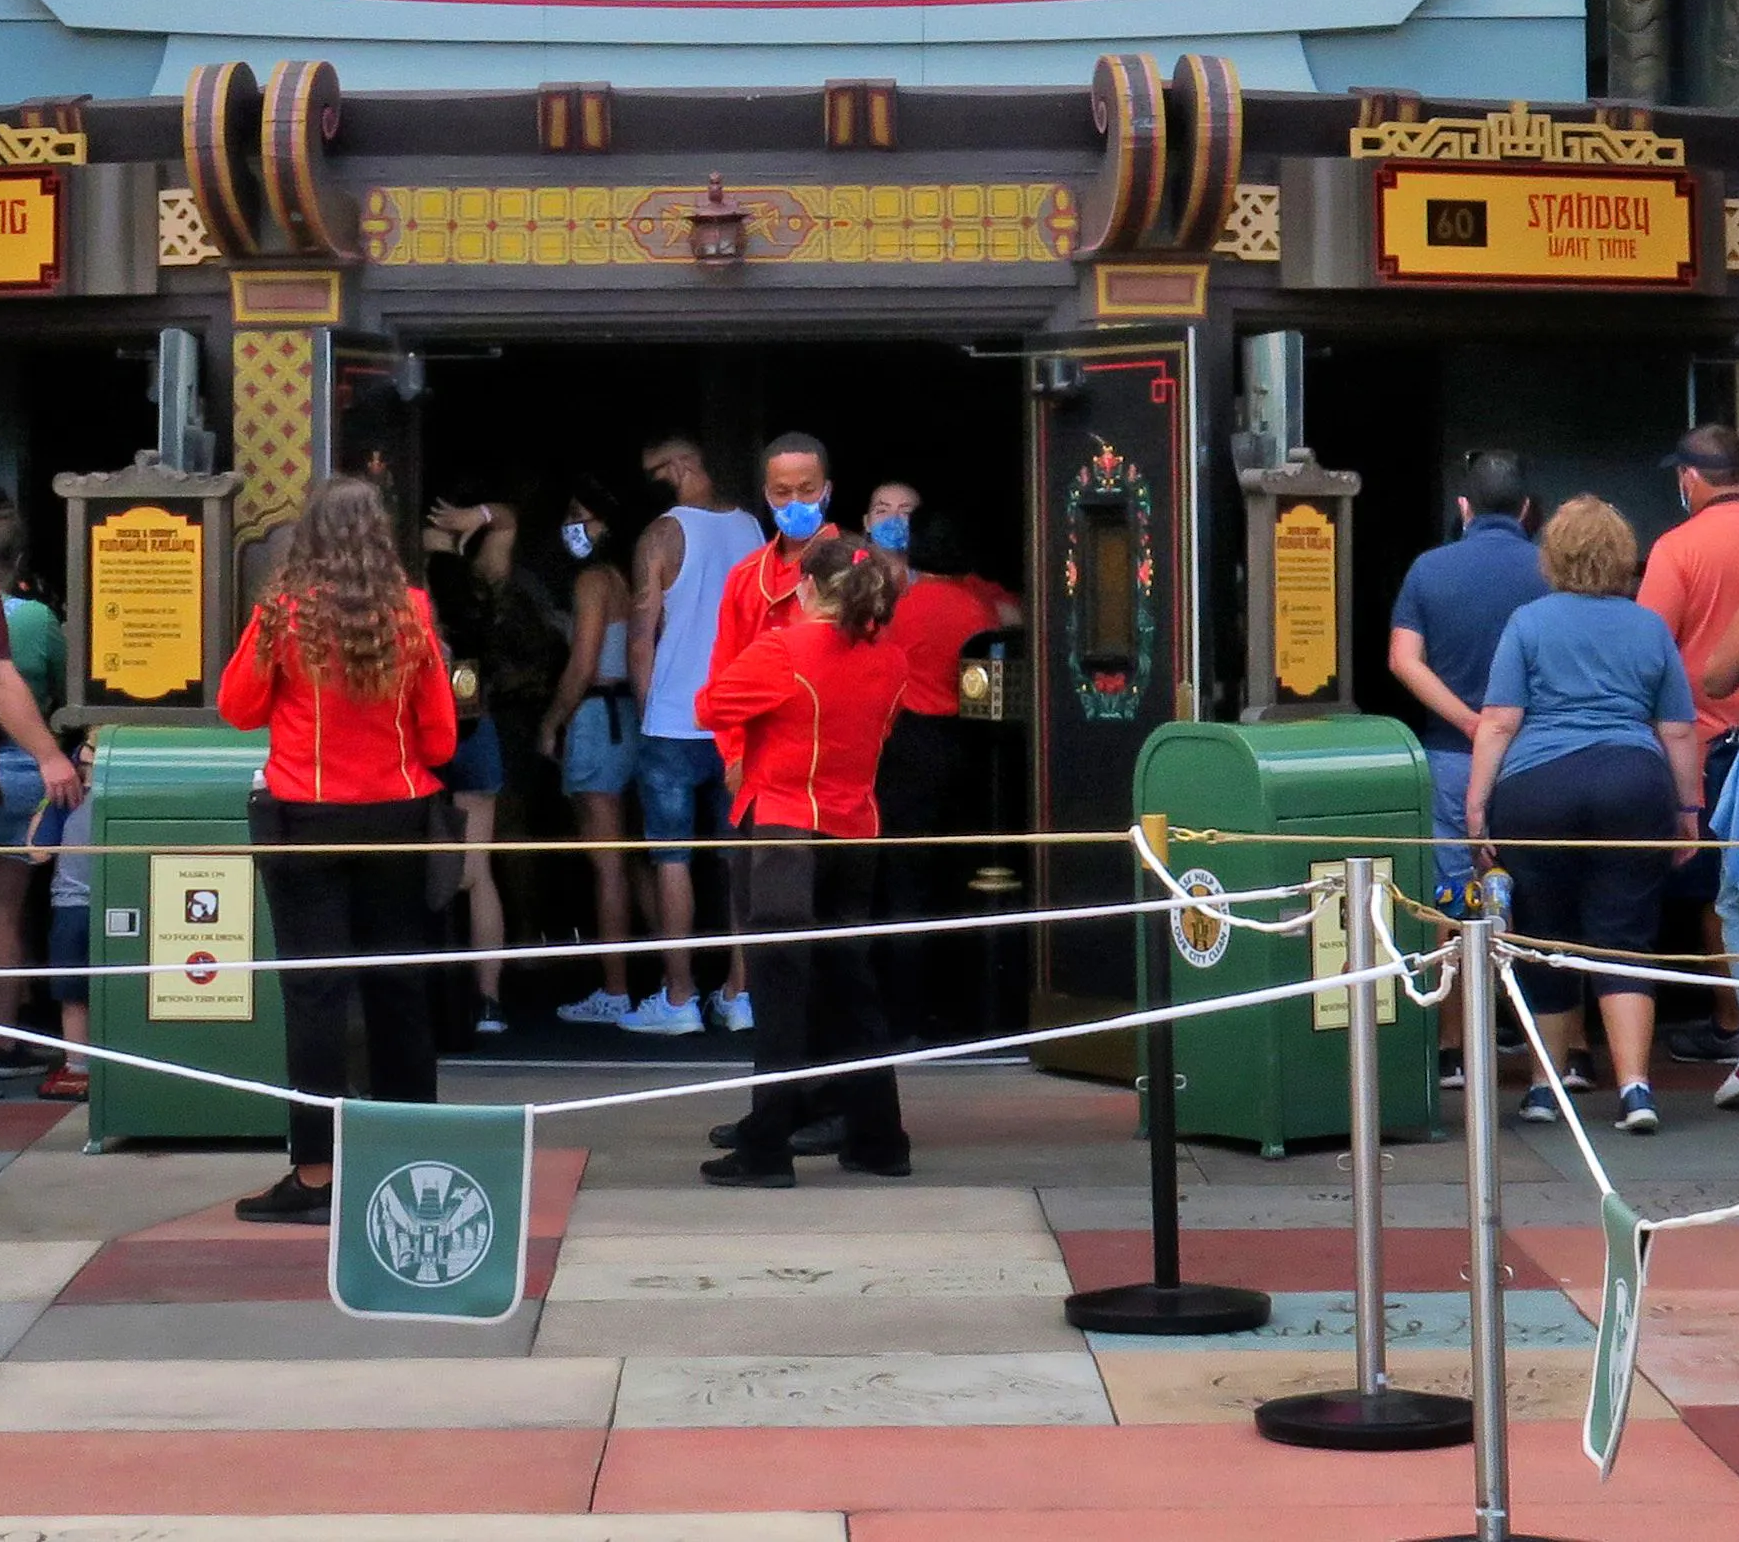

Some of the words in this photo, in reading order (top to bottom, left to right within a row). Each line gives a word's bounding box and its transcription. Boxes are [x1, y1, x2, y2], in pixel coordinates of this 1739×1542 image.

[1436, 208, 1474, 239] 60
[1527, 193, 1651, 236] STANDBY
[1548, 236, 1590, 260] WAIT
[1599, 237, 1637, 260] TIME
